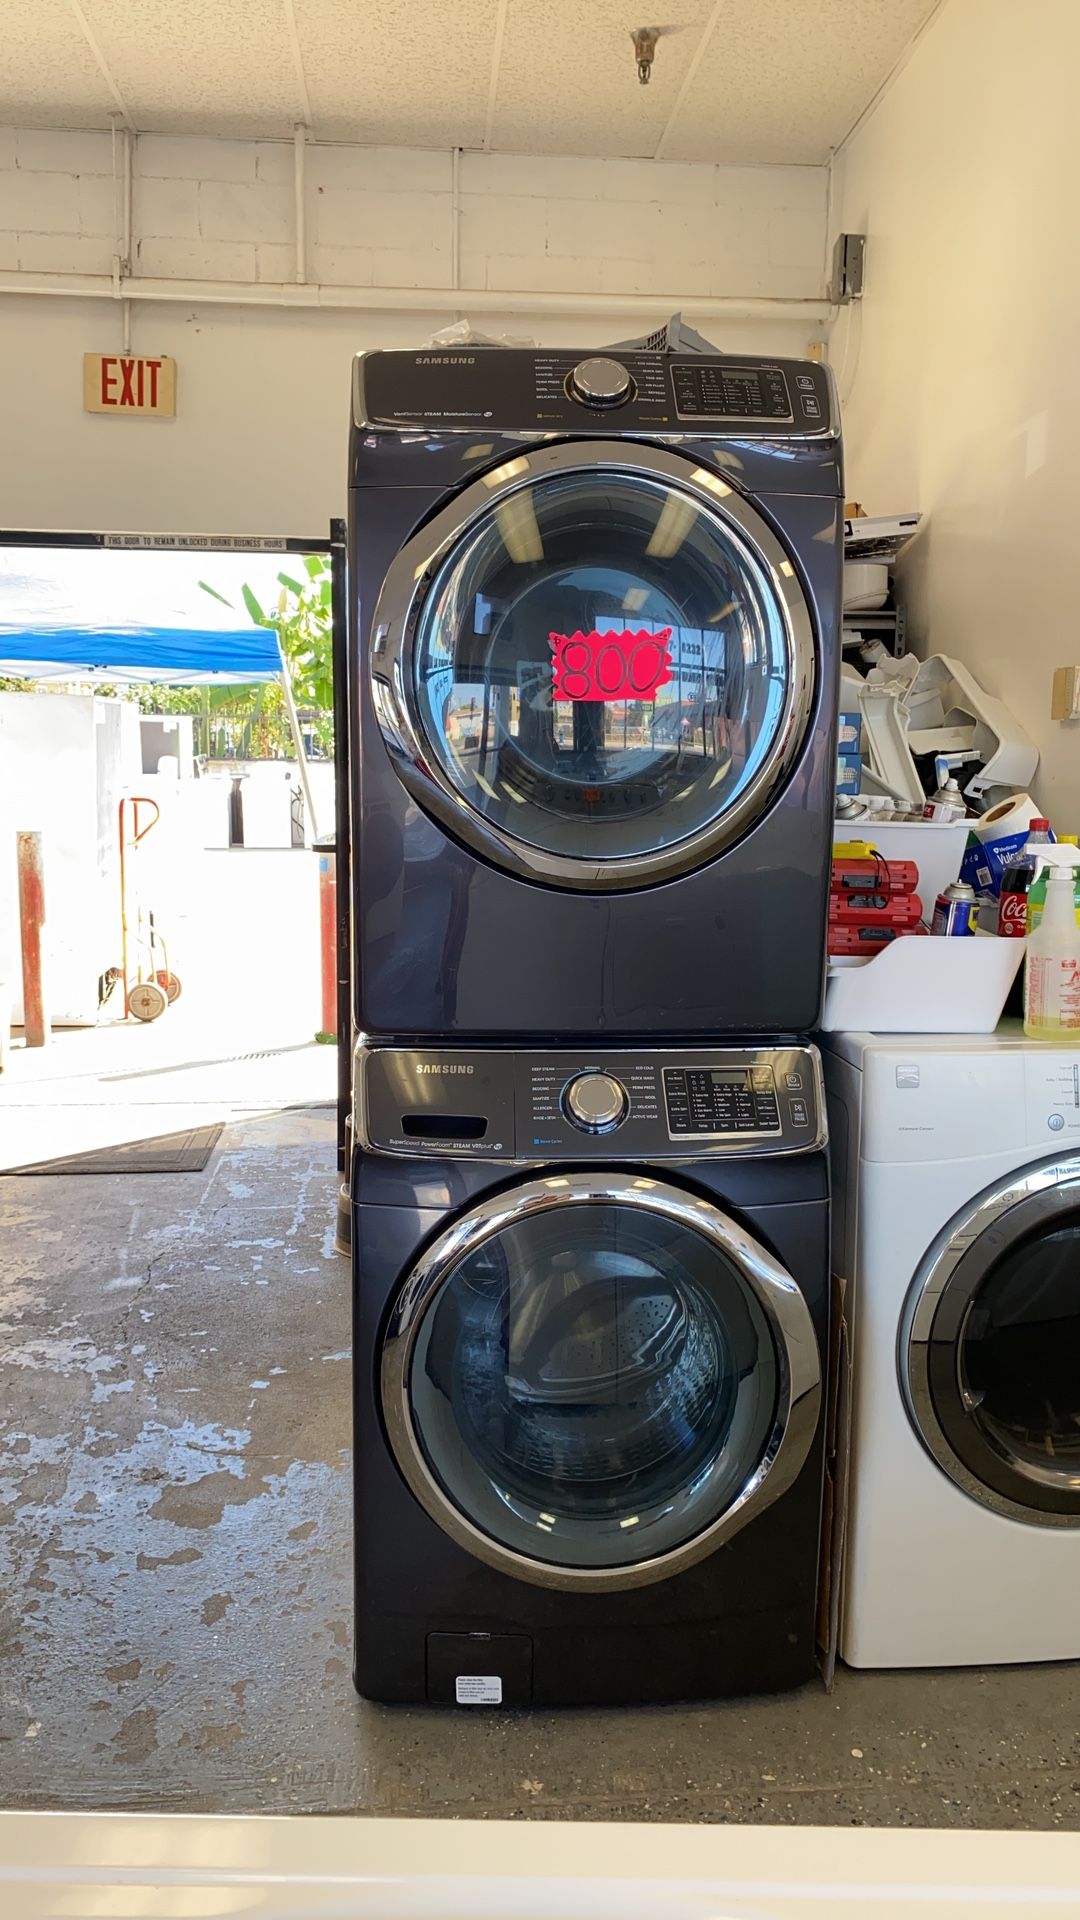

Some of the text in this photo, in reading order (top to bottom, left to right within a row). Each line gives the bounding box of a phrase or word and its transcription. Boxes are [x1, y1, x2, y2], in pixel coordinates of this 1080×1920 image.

[415, 357, 476, 365] SAMSUNG
[101, 357, 162, 408] EXIT
[108, 536, 283, 548] THIS DOOR TO REMAIN UNLOCKED DURING BUSINESS HOURS
[560, 640, 666, 699] 800
[416, 1064, 474, 1074] SAMSUNG
